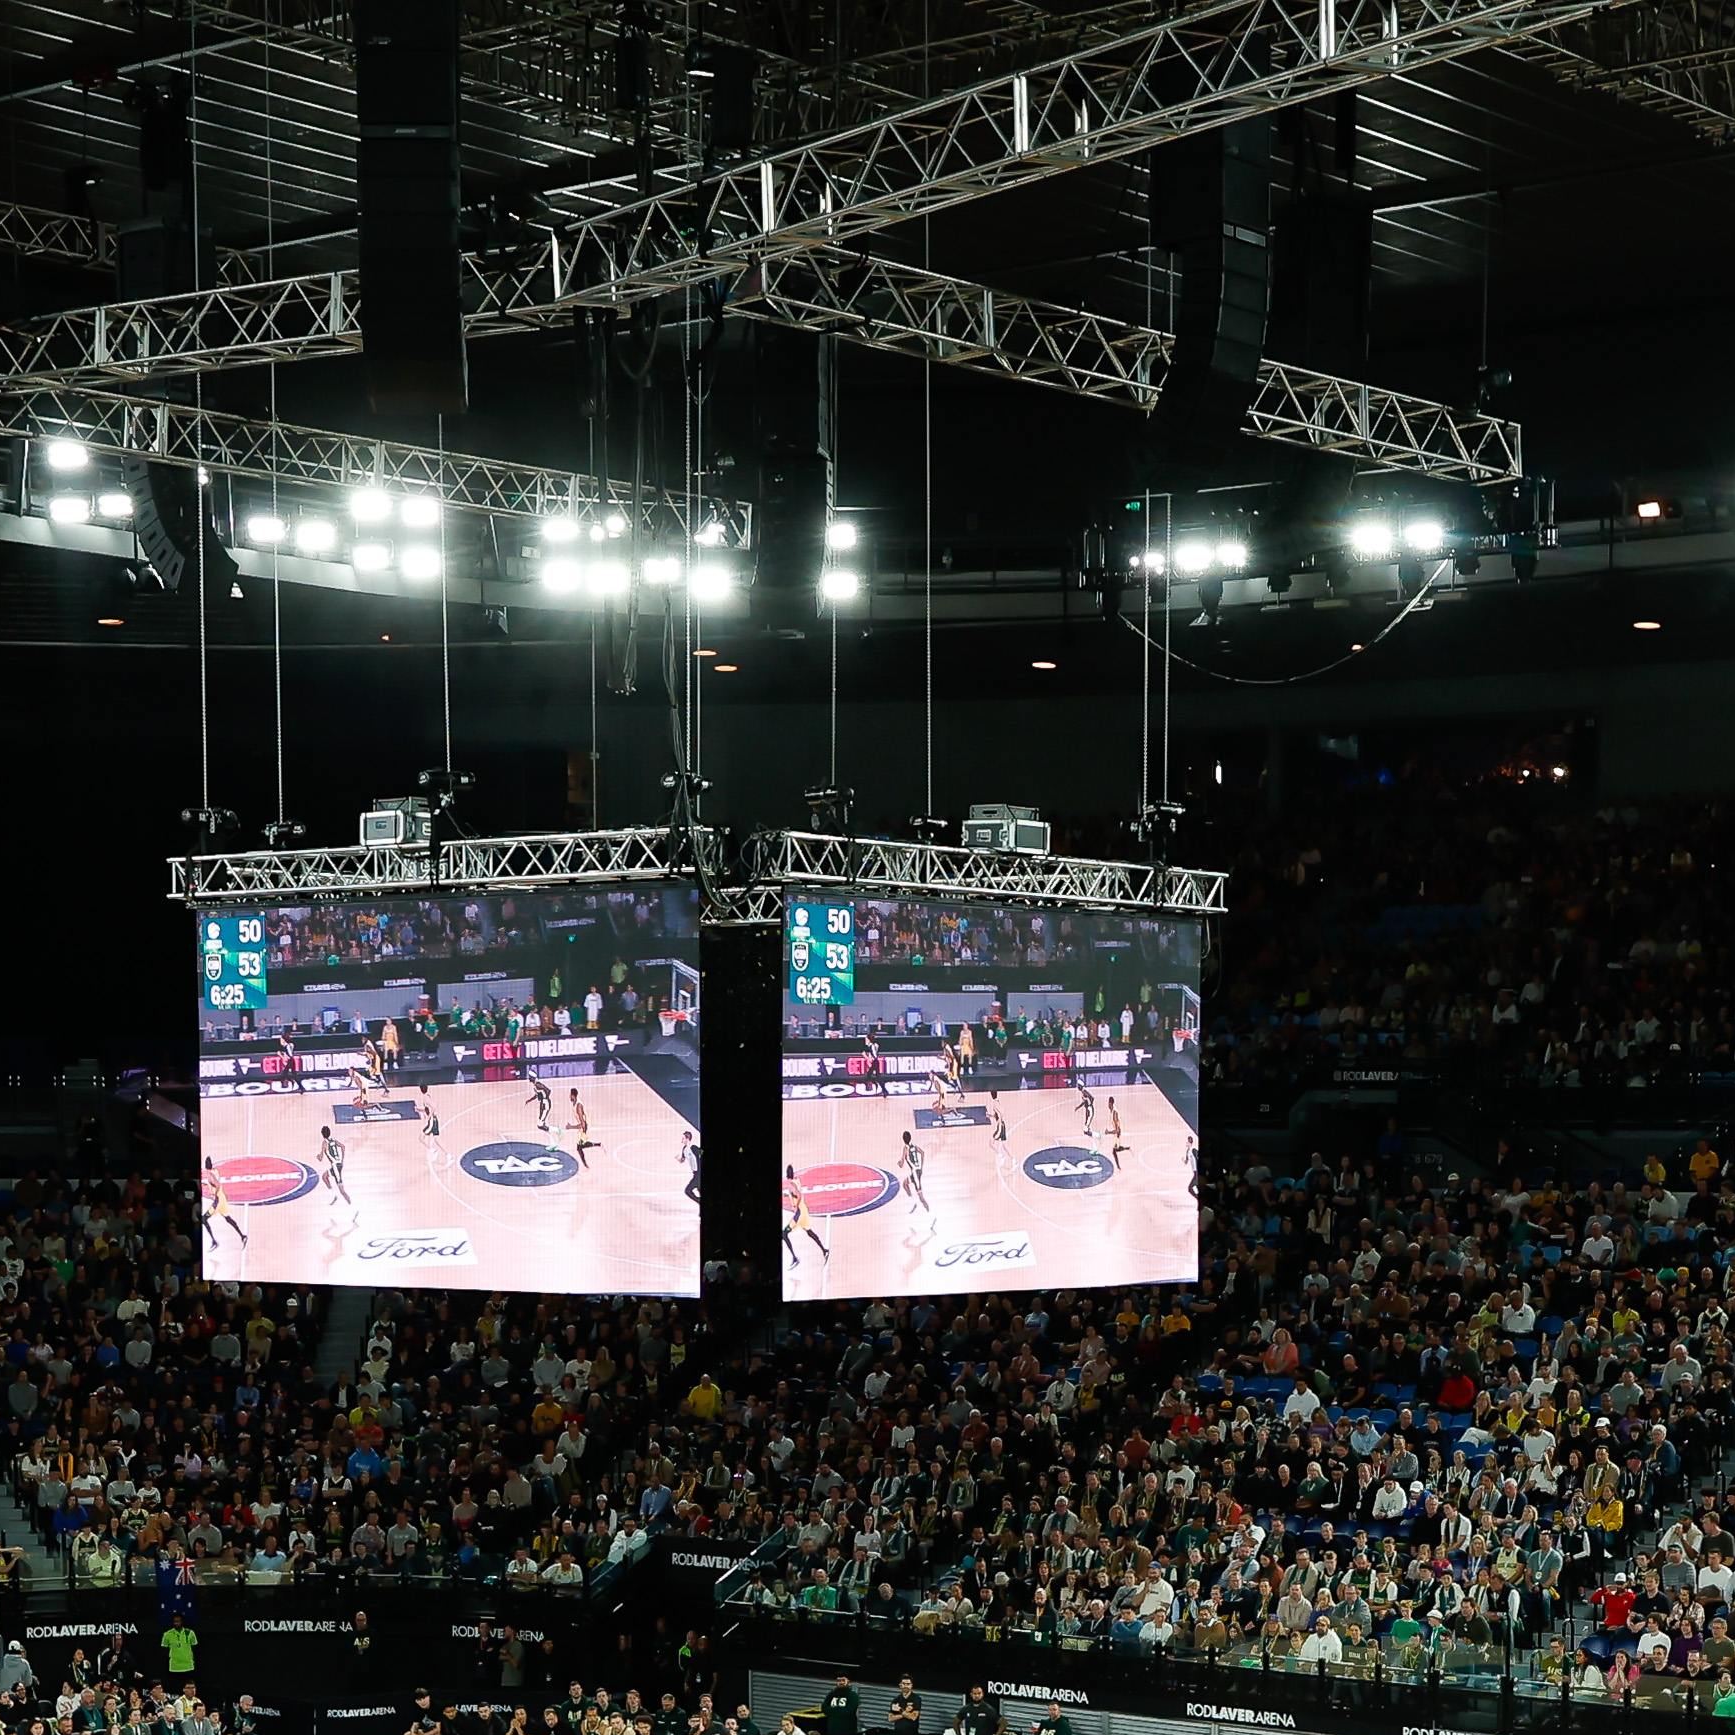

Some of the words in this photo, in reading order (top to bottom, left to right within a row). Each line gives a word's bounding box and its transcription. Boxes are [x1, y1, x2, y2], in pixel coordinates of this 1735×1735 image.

[238, 919, 262, 943] 50
[827, 908, 851, 934] 50
[238, 953, 260, 976] 53
[825, 944, 849, 970] 53
[210, 984, 244, 1006] 6:25
[796, 976, 831, 999] 6:25
[199, 1058, 237, 1078] BOURNE
[782, 1058, 822, 1077] BOURNE
[474, 1155, 564, 1174] TAC
[1035, 1159, 1103, 1177] TAC
[220, 1168, 304, 1185] LBOURNE
[358, 1236, 468, 1259] Ford
[935, 1240, 1030, 1268] Ford
